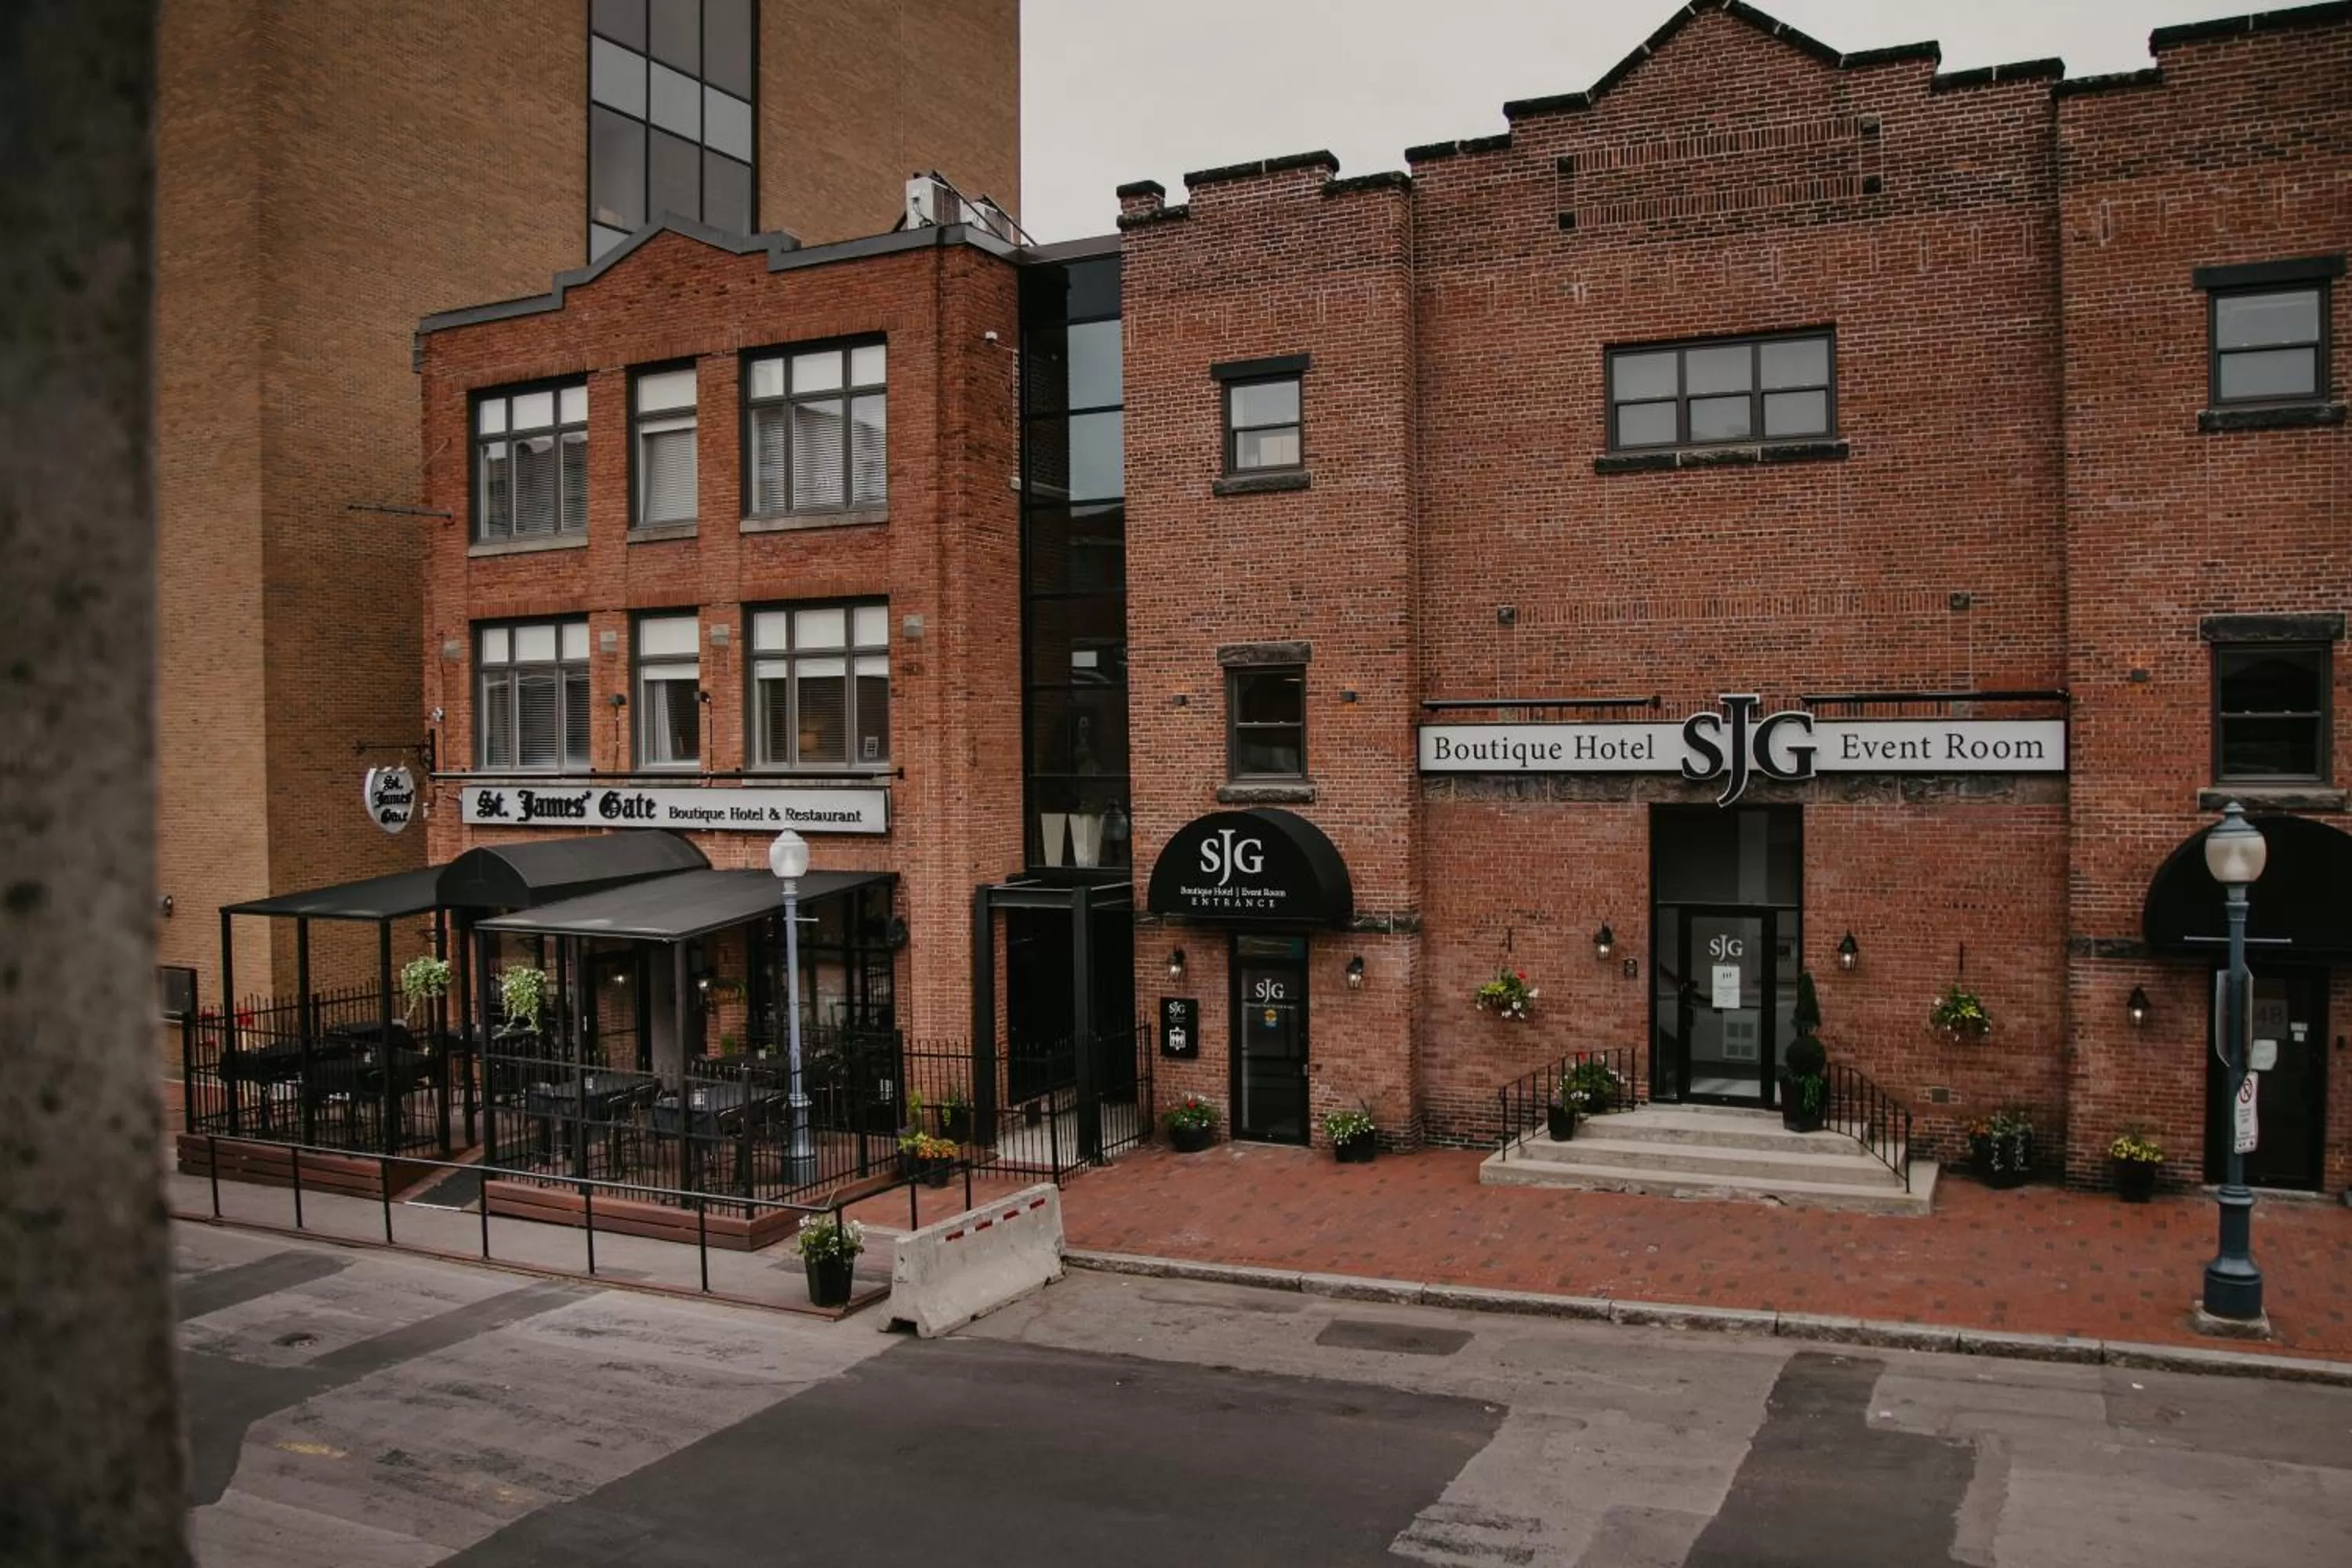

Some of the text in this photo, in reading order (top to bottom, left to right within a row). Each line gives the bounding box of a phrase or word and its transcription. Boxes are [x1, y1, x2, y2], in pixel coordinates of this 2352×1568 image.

[1433, 734, 1656, 768] Boutique Hotel
[1681, 694, 1817, 808] SJG
[1840, 733, 2045, 760] Event Room
[476, 789, 657, 822] St. James' Gate
[669, 806, 862, 823] Boutique Hotel & Restaurant
[1200, 829, 1264, 886] SJG
[1180, 886, 1213, 897] Boutique
[1214, 887, 1233, 897] Hotel
[1241, 887, 1262, 897] Event
[1263, 888, 1287, 898] Room
[1191, 898, 1276, 908] ENTRANCE
[1709, 934, 1744, 961] SJG
[1255, 978, 1285, 1003] SJG
[1168, 1001, 1186, 1017] SJG
